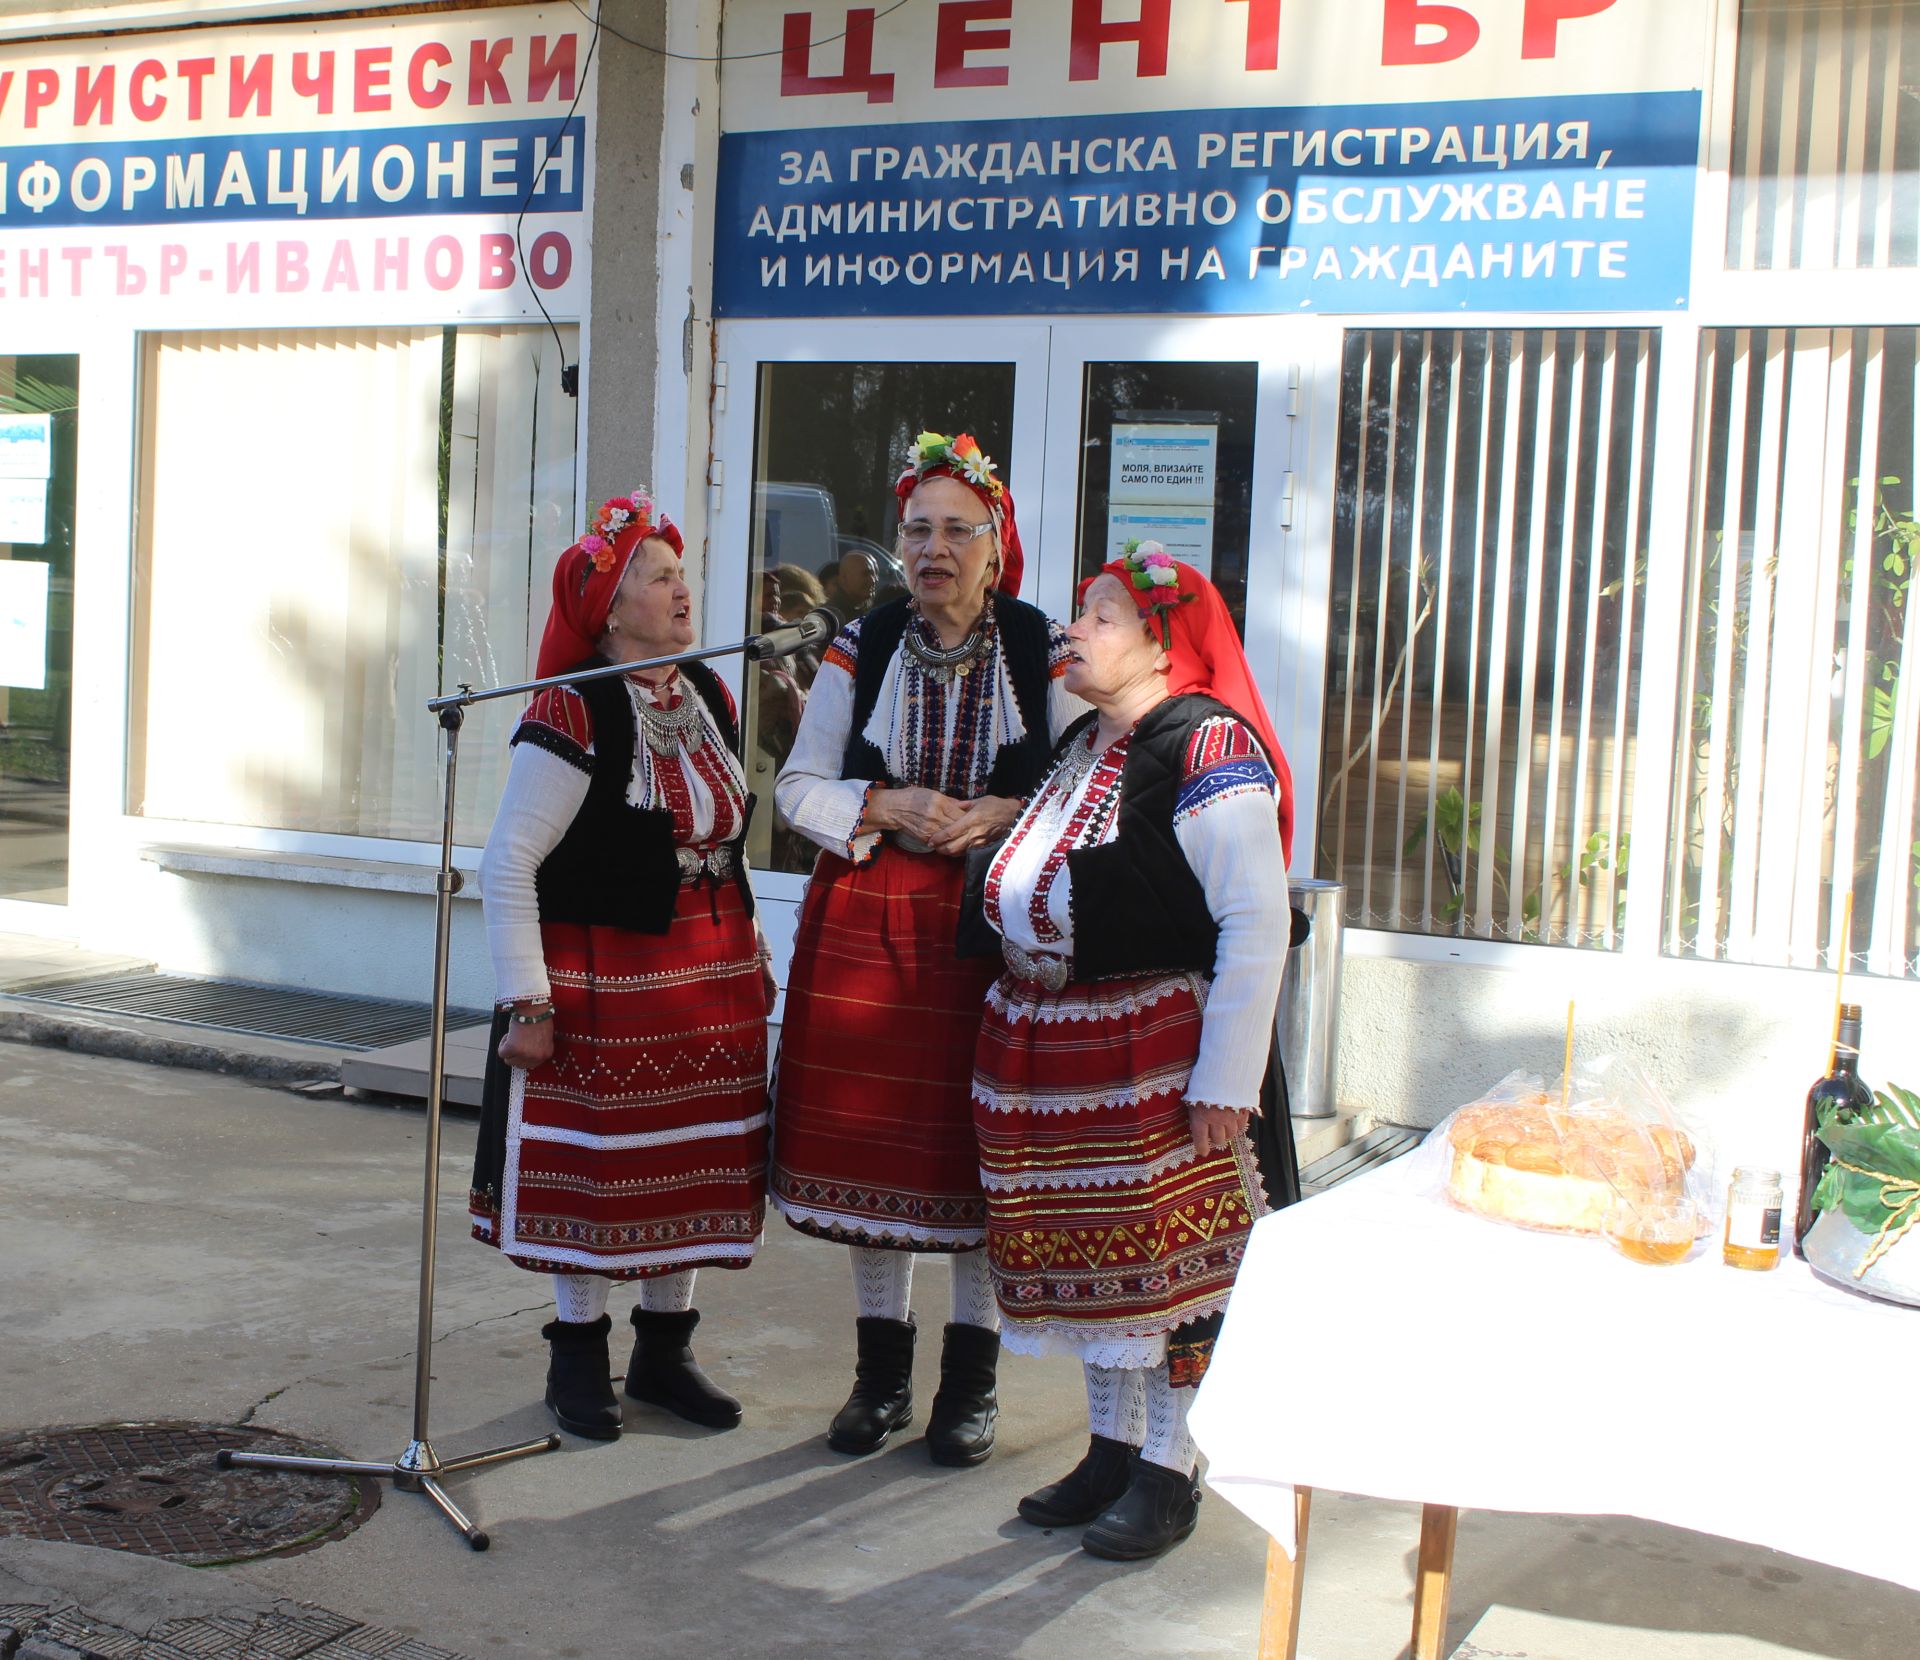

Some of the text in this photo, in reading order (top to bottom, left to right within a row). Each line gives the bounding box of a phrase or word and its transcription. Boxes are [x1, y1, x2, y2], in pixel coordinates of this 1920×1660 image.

[0, 136, 574, 214] ФОРМАЦИОНЕН
[778, 121, 1613, 185] ЗА ГРАЖДАНСКА РЕГИСТРАЦИЯ,
[747, 179, 1647, 243] АДМИНИСТРАТИВНО ОБСЛУЖВАНЕ
[0, 232, 572, 298] НТЪР-ИВАНОВО
[760, 240, 1629, 290] И ИНФОРМАЦИЯ НА ГРАЖДАНИТЕ
[1121, 475, 1204, 485] САМО ПО ЕДИН !!!
[1122, 463, 1204, 473] МОЛЯ, ВЛИЗАЙТЕ
